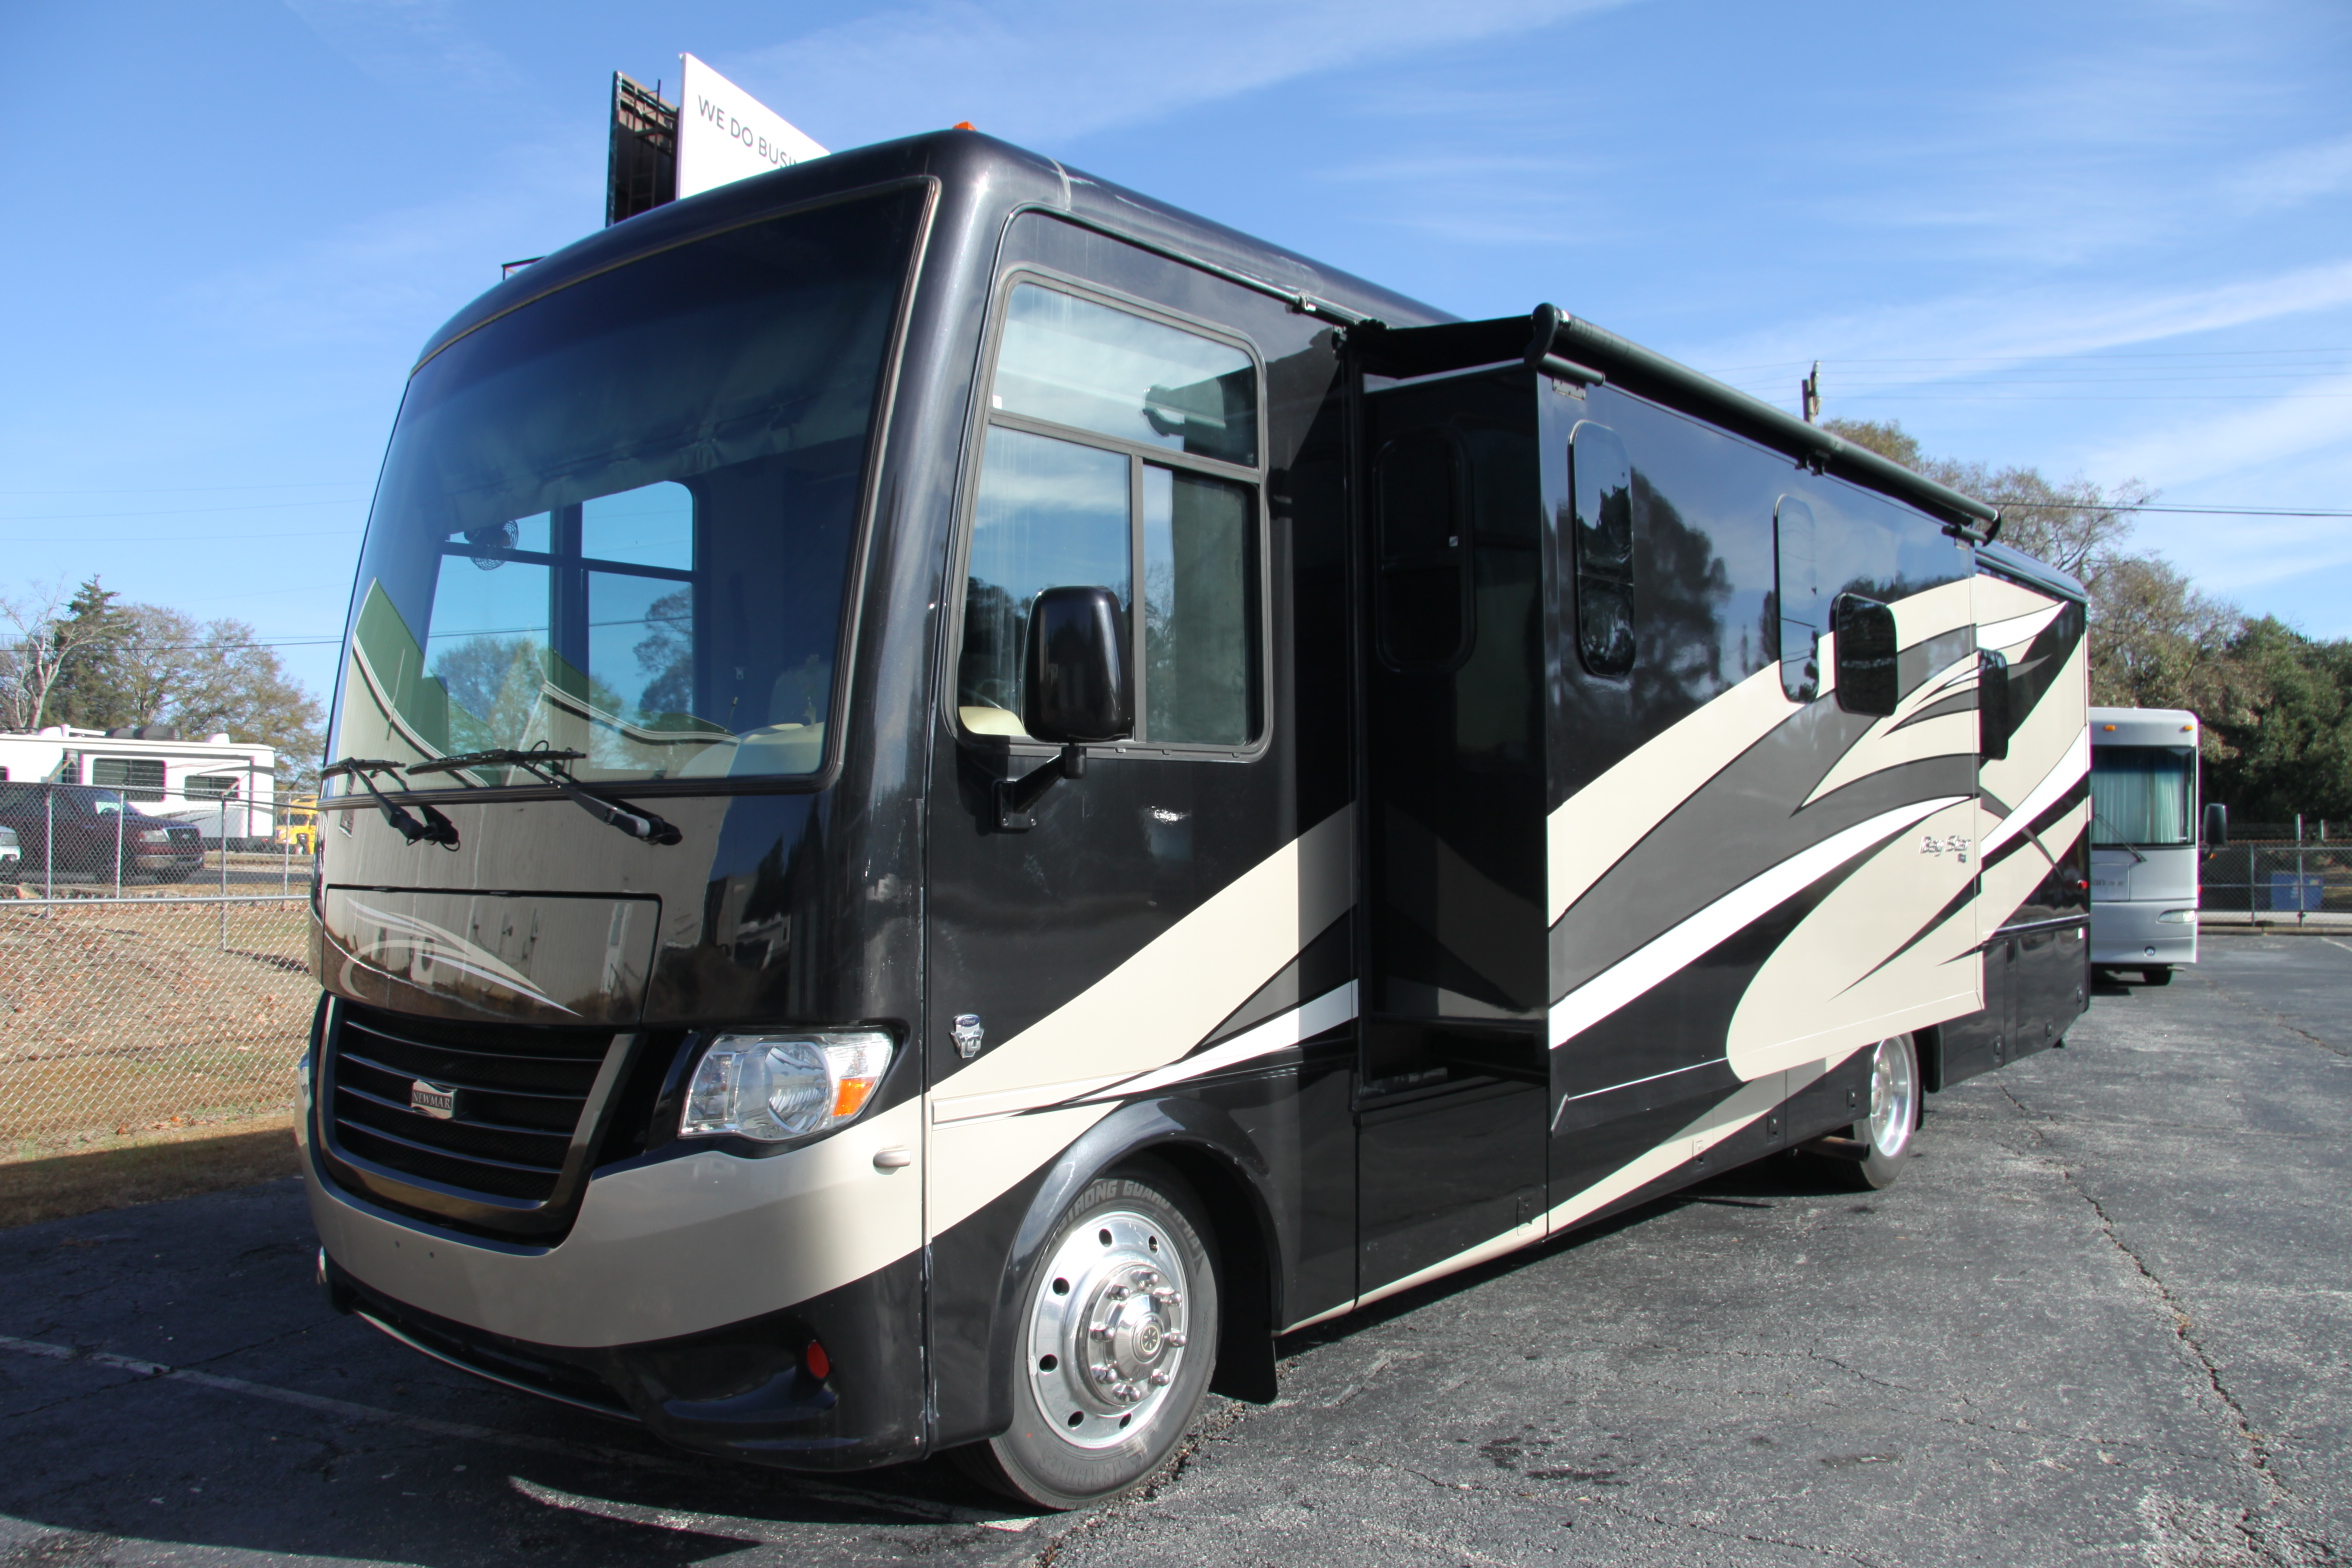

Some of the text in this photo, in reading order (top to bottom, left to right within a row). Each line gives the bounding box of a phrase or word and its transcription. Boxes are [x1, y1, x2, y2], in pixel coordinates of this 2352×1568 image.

[698, 94, 798, 168] WE DO BUSI
[1919, 836, 1944, 858] Bay
[1945, 834, 1971, 852] Star
[412, 1092, 452, 1109] NEWMAR
